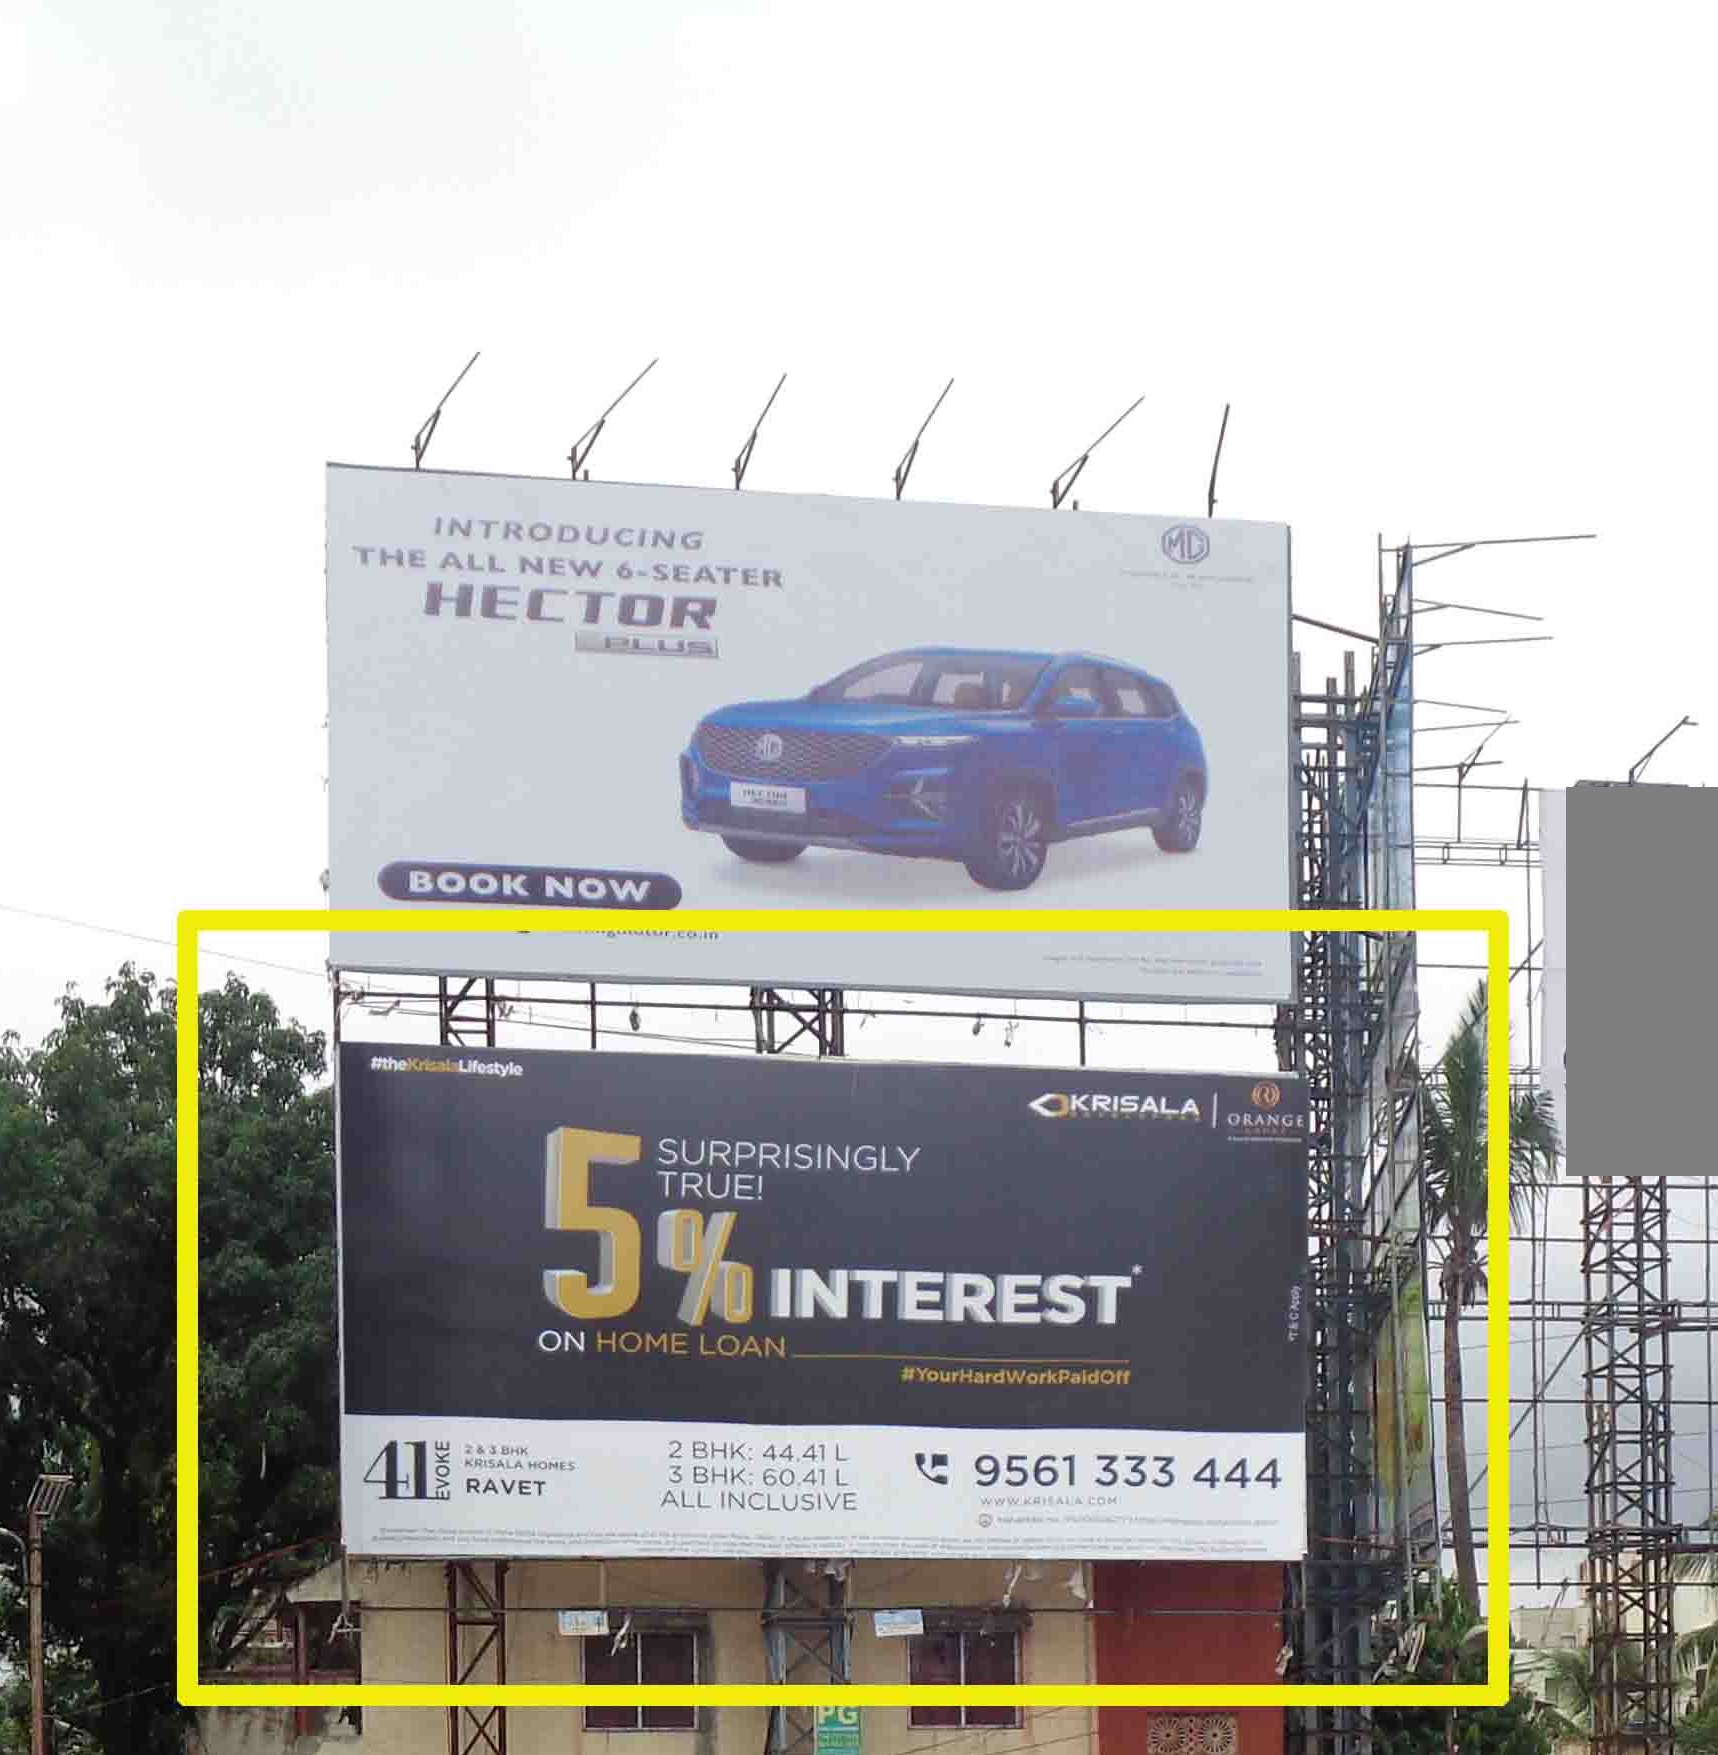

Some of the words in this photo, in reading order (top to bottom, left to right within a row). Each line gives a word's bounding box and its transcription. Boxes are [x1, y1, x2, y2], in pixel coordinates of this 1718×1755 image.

[433, 516, 704, 551] INTRODUCING
[1164, 525, 1207, 562] MG
[353, 545, 428, 569] THE
[438, 550, 507, 574] ALL
[518, 555, 604, 579] NEW
[615, 562, 784, 589] 6-SEATER
[423, 580, 718, 630] HECTOR
[601, 636, 716, 656] PLUS
[407, 870, 529, 897] BOOK
[544, 875, 650, 902] NOW
[369, 1055, 524, 1078] #theKrisalaLifestyle
[1070, 1093, 1200, 1116] KRISALA
[1226, 1112, 1305, 1128] ORANGE
[658, 1138, 922, 1173] SURPRISINGLY
[658, 1170, 764, 1201] TRUE!
[537, 1329, 586, 1353] ON
[596, 1331, 689, 1355] HOME
[698, 1334, 787, 1359] LOAN
[899, 1366, 1132, 1386] #YourHardWorkPaidOff
[500, 1446, 529, 1457] BHK
[668, 1440, 683, 1459] 2
[692, 1440, 754, 1462] BHK:
[762, 1443, 826, 1462] 44.41
[835, 1444, 851, 1462] L
[362, 1439, 429, 1500] 41
[434, 1439, 451, 1500] EVOKE
[464, 1458, 524, 1471] KRISALA
[528, 1460, 576, 1472] HOMES
[668, 1465, 683, 1484] 3
[692, 1466, 754, 1486] BHK:
[762, 1468, 826, 1487] 60.41
[835, 1469, 851, 1487] L
[973, 1453, 1076, 1488] 9561
[1094, 1454, 1176, 1488] 333
[1192, 1457, 1282, 1490] 444
[466, 1477, 547, 1497] RAVET
[659, 1489, 712, 1509] ALL
[720, 1491, 858, 1512] INCLUSIVE
